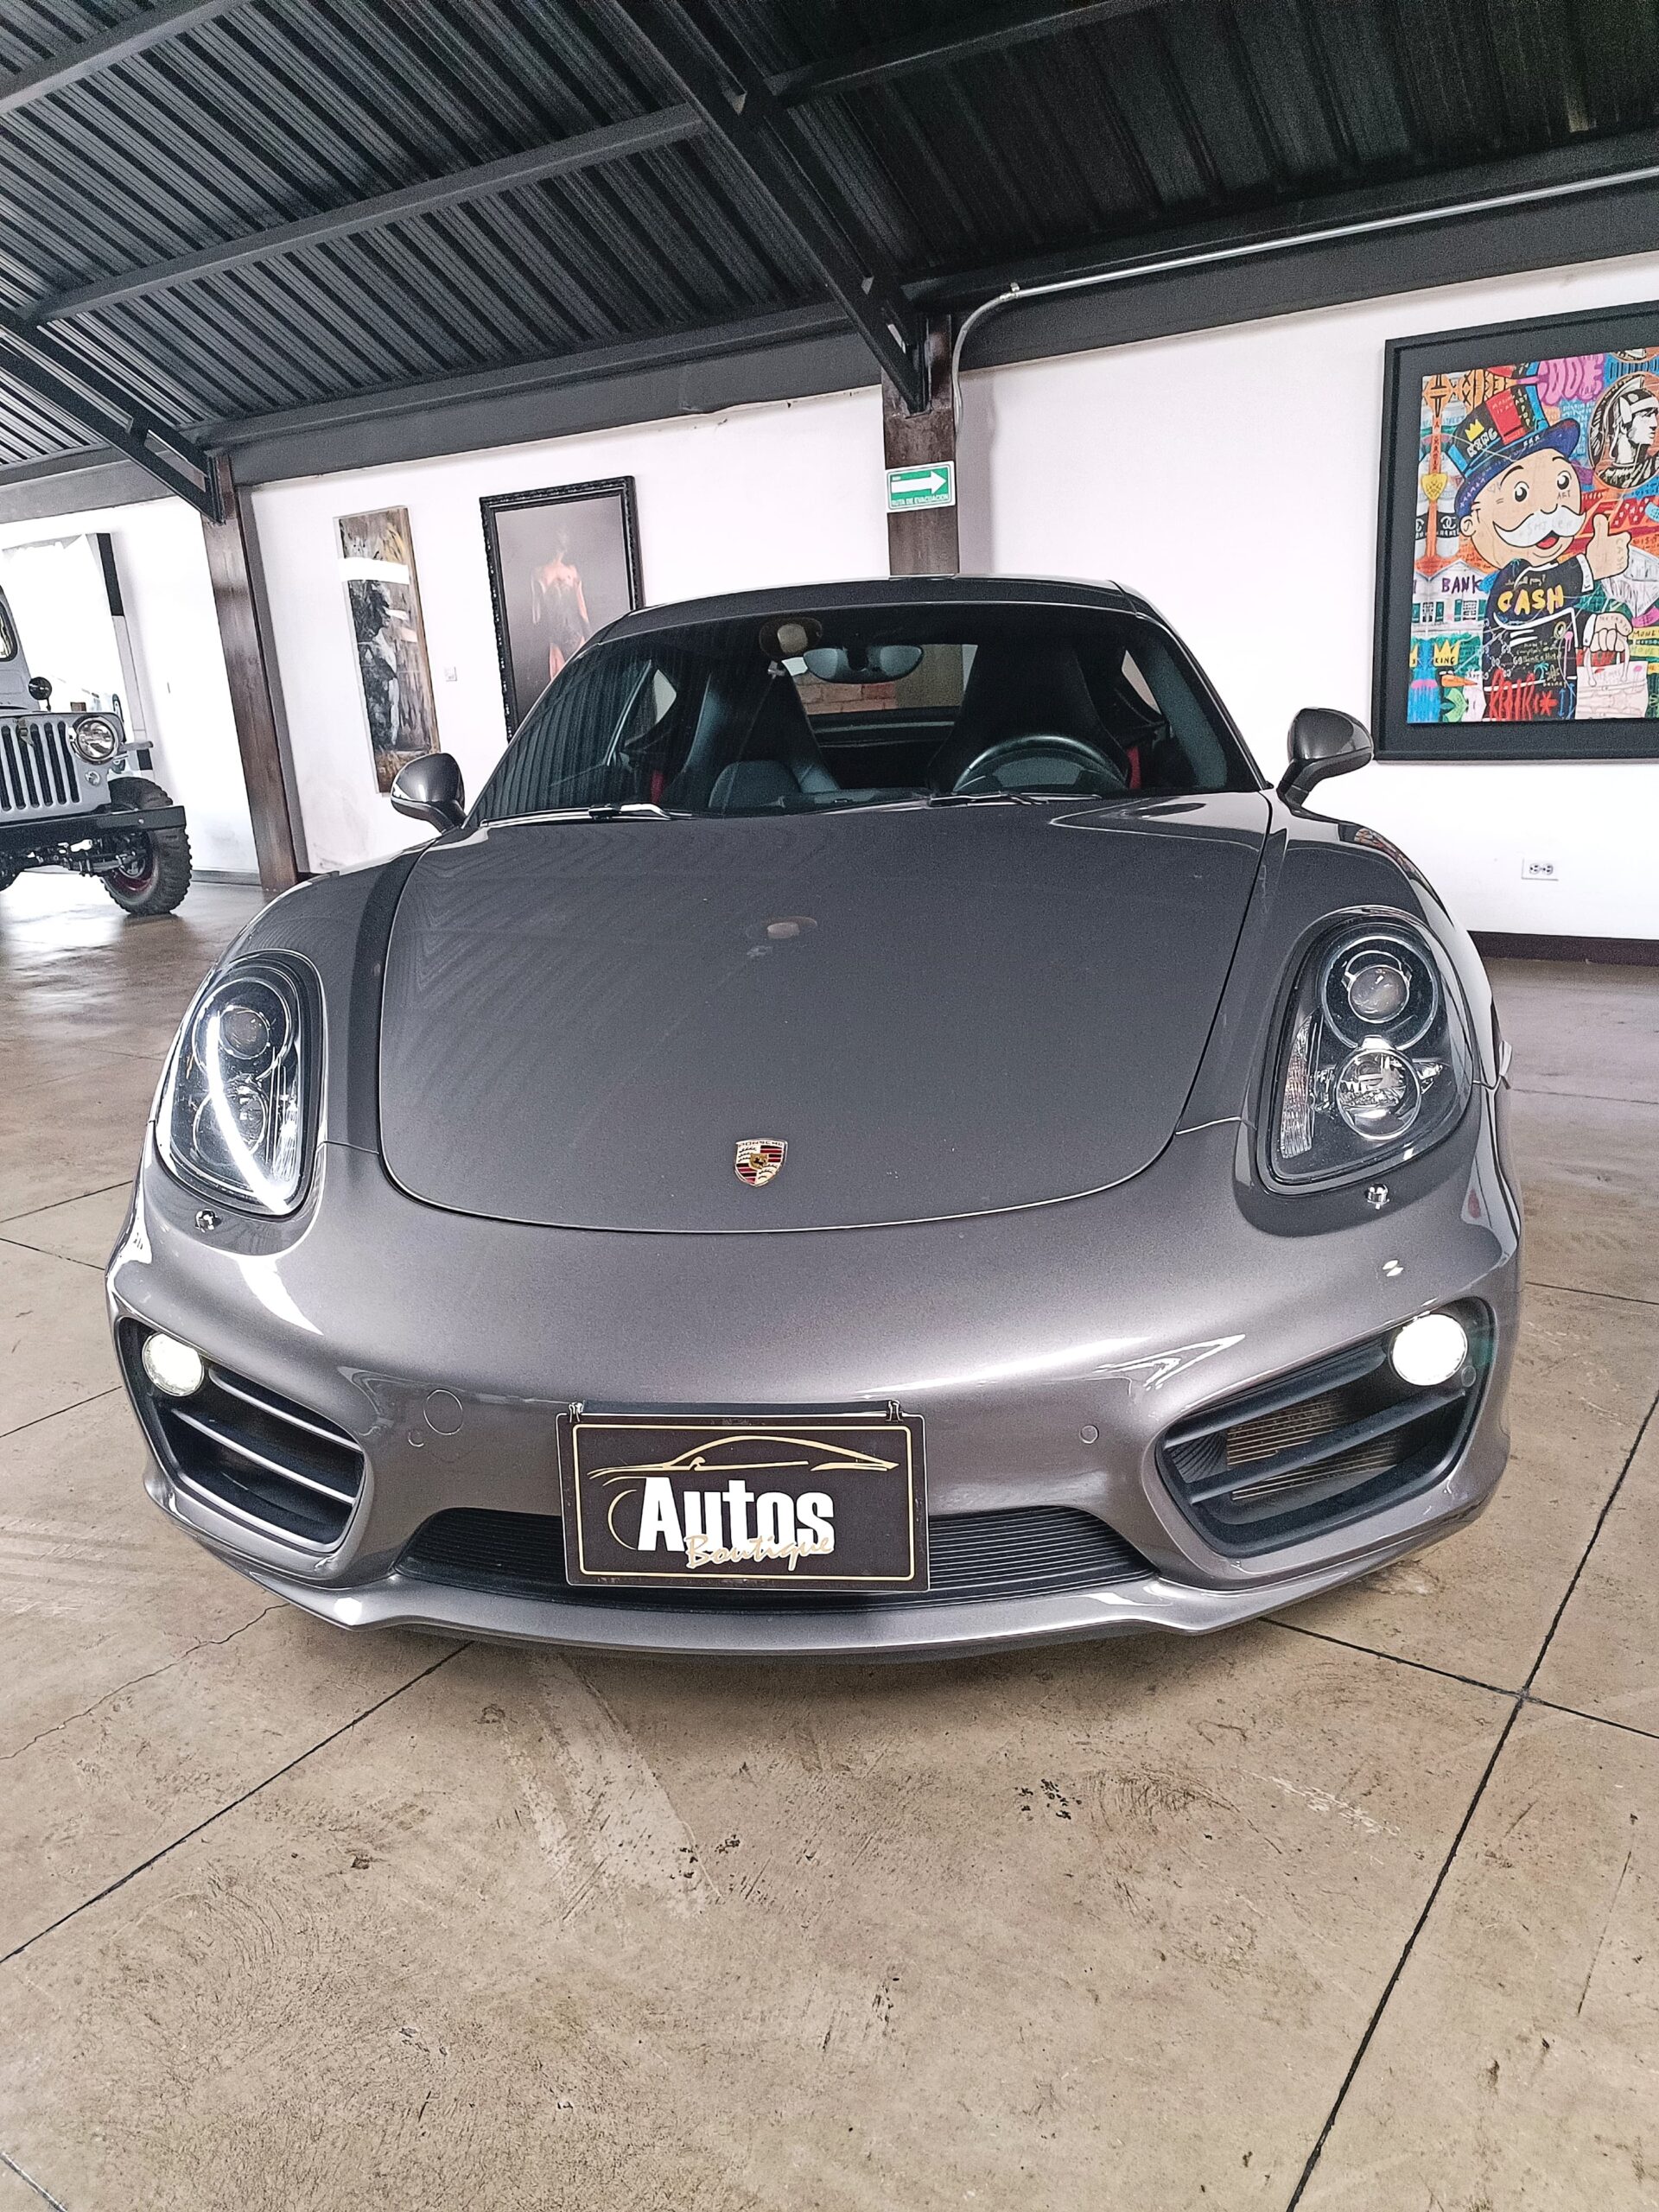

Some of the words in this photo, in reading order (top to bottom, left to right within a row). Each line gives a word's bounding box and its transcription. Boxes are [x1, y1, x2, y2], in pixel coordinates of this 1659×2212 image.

[1466, 428, 1498, 458] KING
[1441, 575, 1484, 594] BANK
[1497, 585, 1564, 615] CASH
[638, 1477, 835, 1554] Autos
[685, 1534, 835, 1571] Boutique
